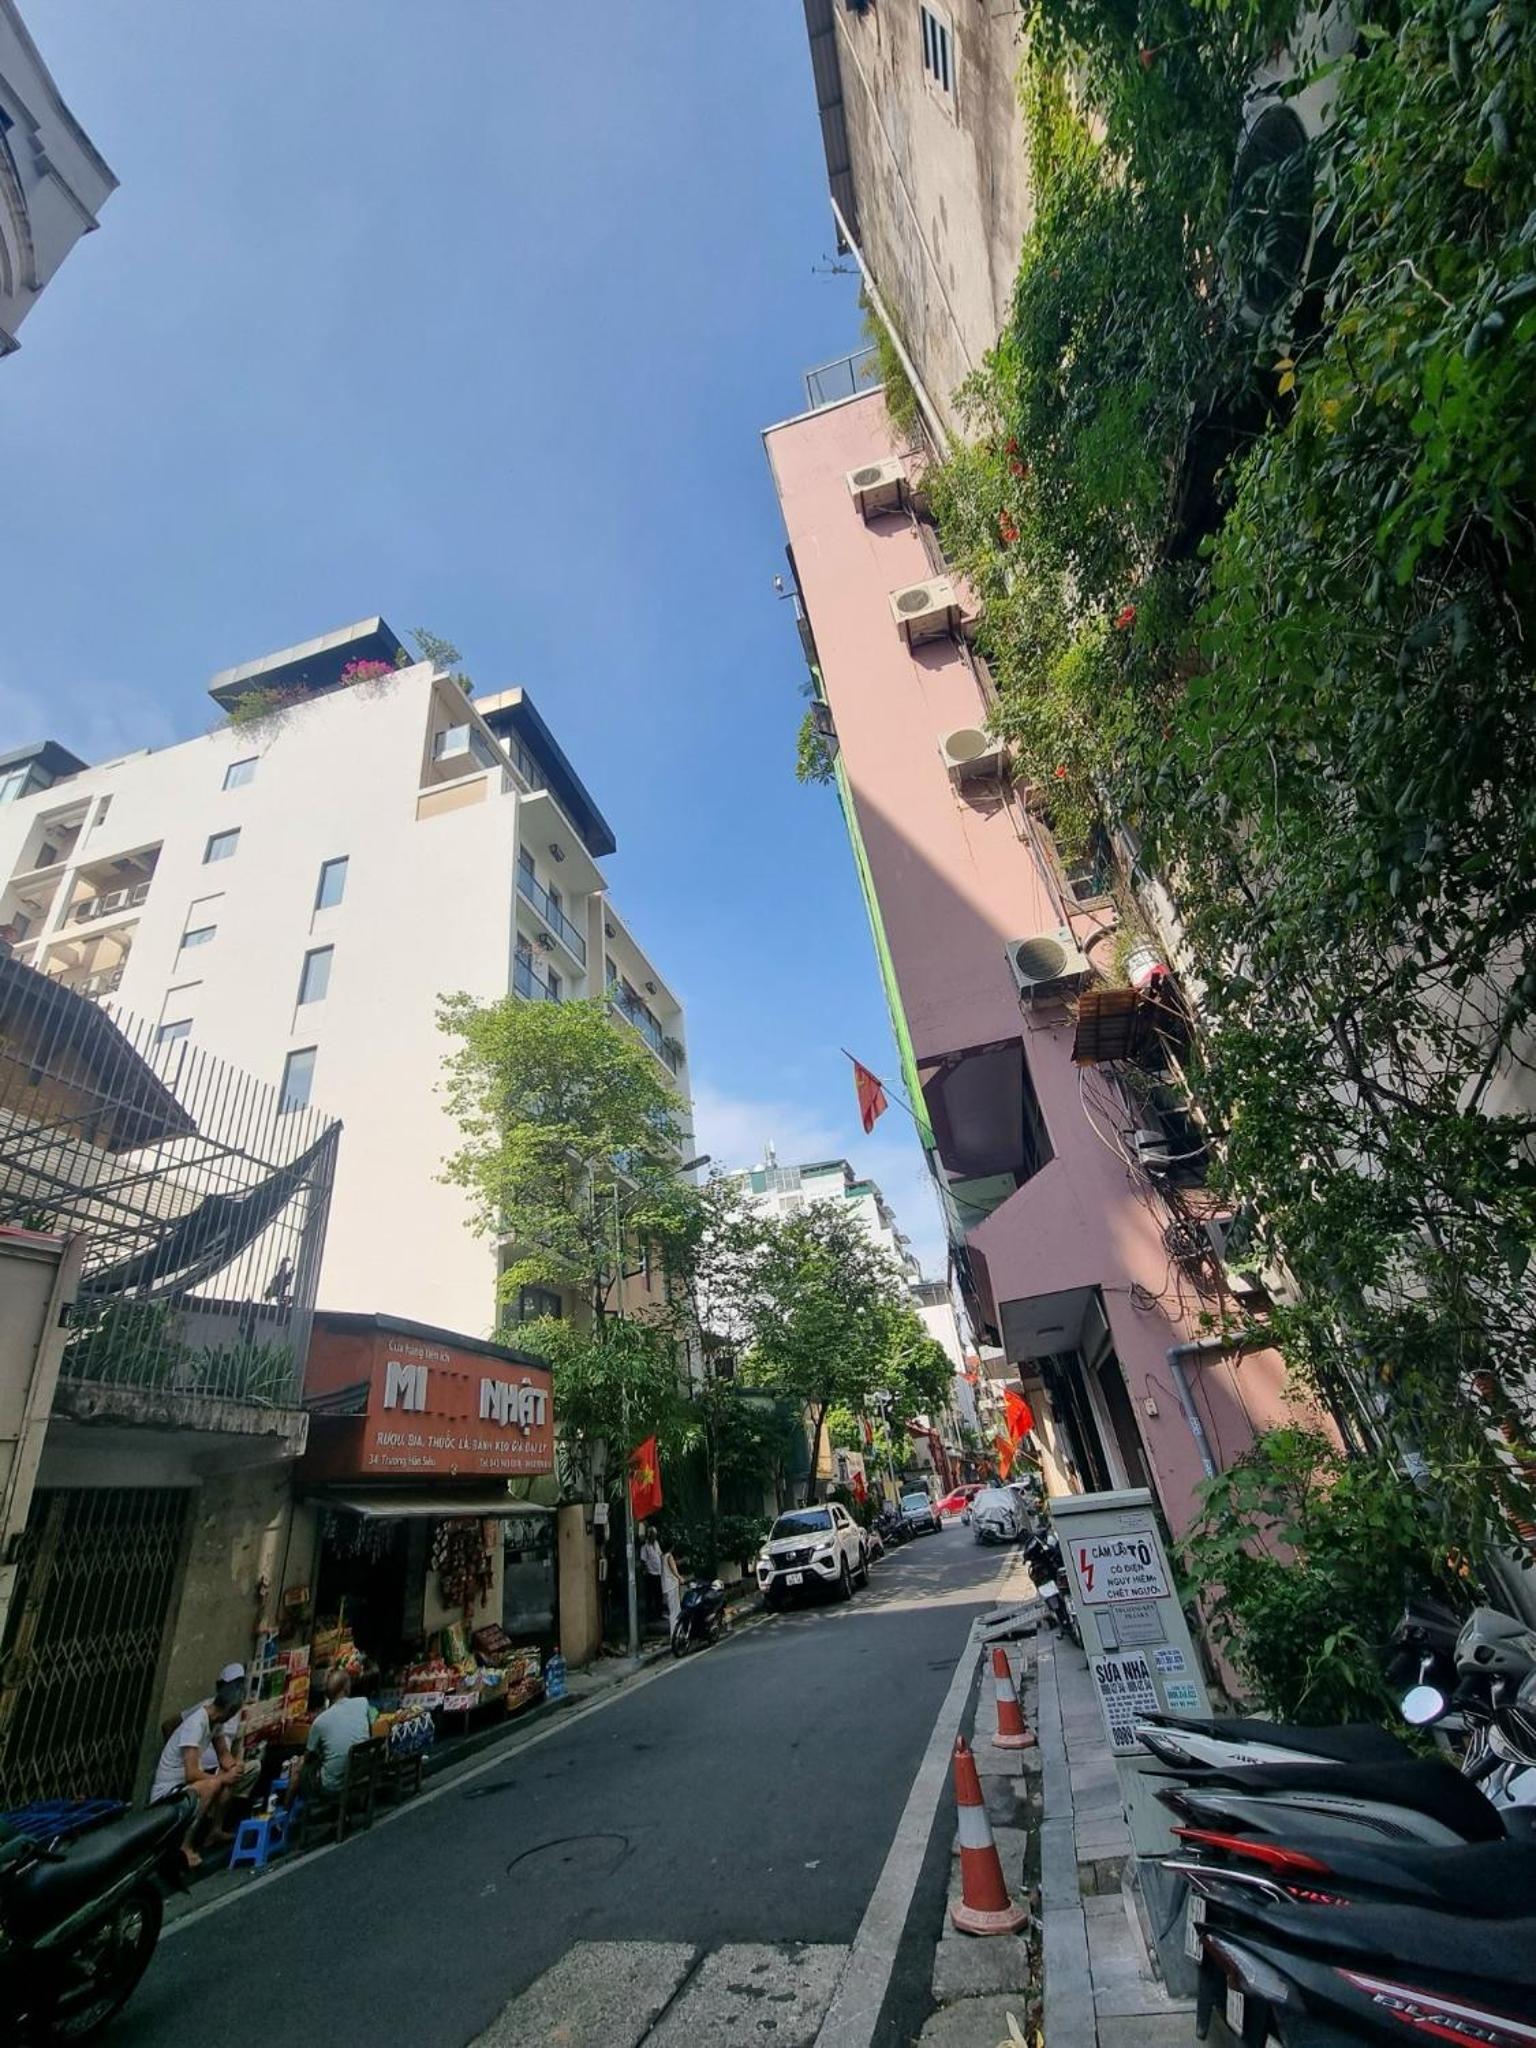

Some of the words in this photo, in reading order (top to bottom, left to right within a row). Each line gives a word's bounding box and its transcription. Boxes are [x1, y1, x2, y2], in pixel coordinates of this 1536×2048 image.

[384, 1361, 428, 1411] MI
[479, 1377, 549, 1436] NHẬT
[1096, 1656, 1122, 1684] SỬA
[1122, 1656, 1150, 1680] NHÀ
